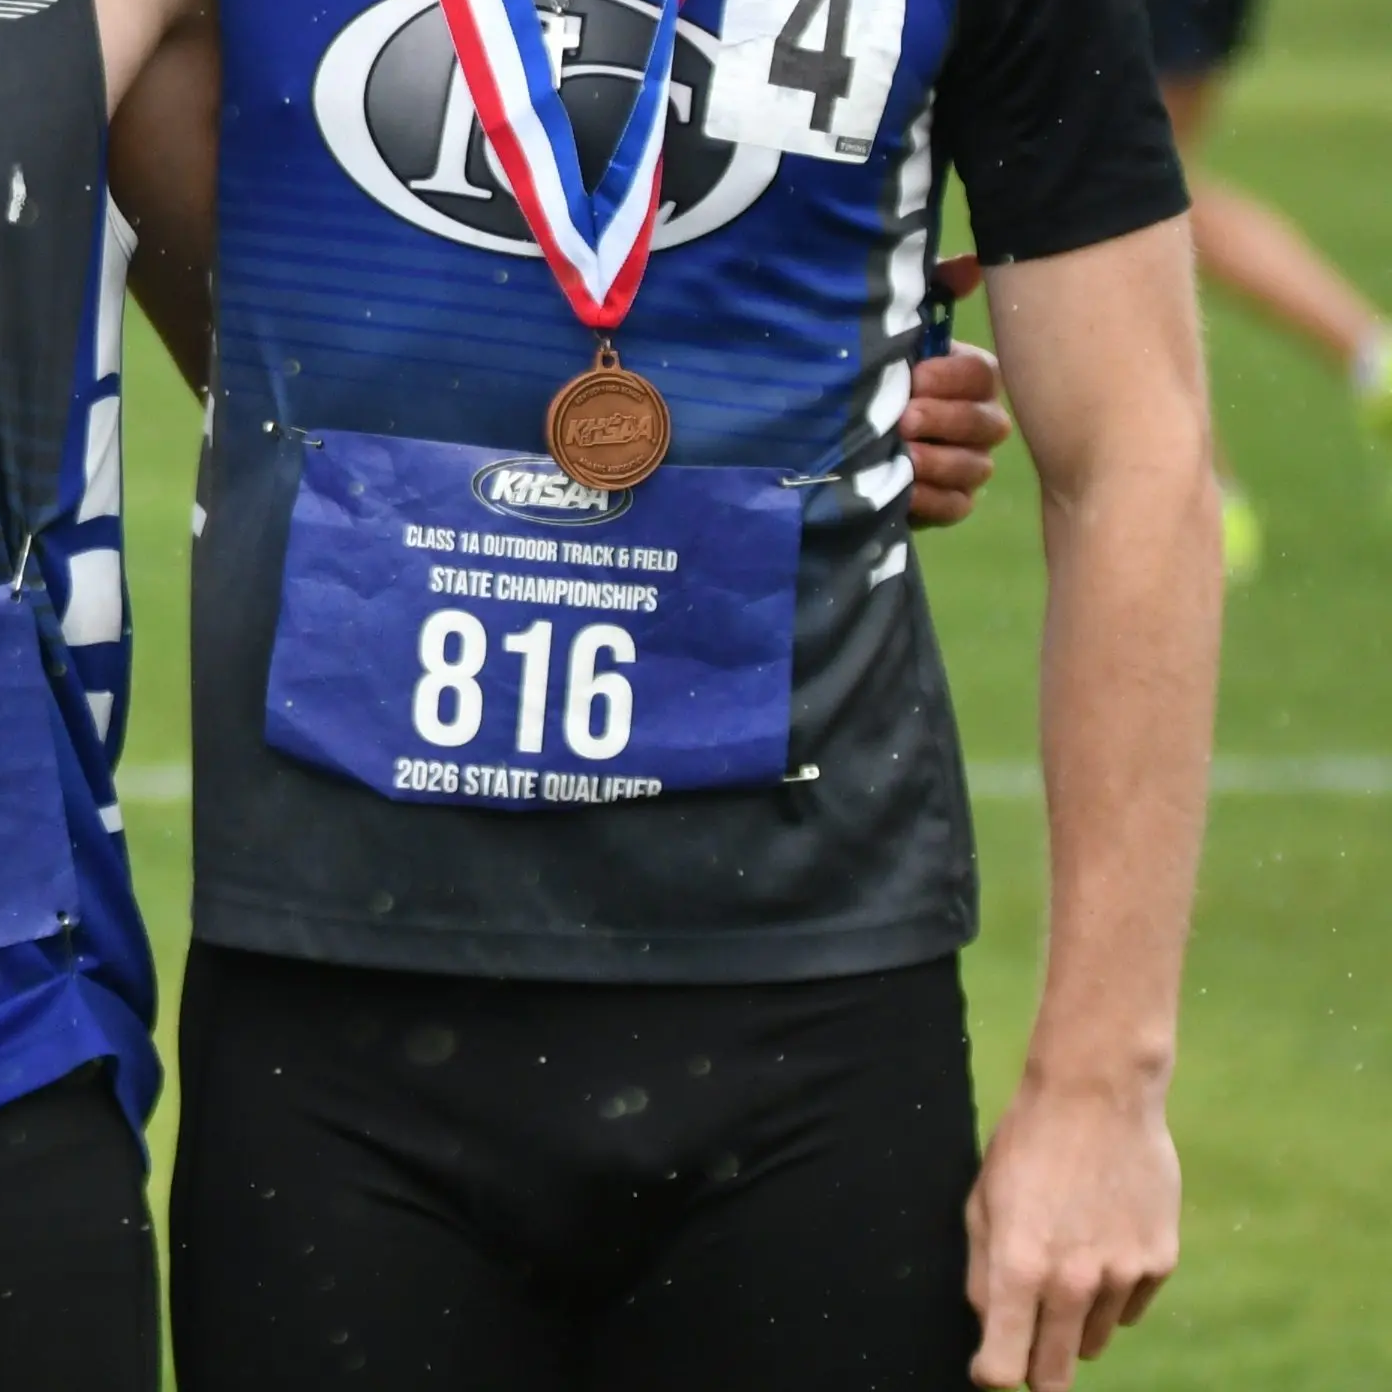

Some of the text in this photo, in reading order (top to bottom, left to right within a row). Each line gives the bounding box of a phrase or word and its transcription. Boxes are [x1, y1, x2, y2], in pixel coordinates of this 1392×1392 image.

[405, 526, 678, 573] CLASS 1A OUTDOOR TRACK & FIELD
[430, 566, 659, 614] STATE CHAMPIONSHIPS
[412, 609, 637, 760] 816
[394, 759, 459, 794] 2026
[463, 766, 537, 800] STATE
